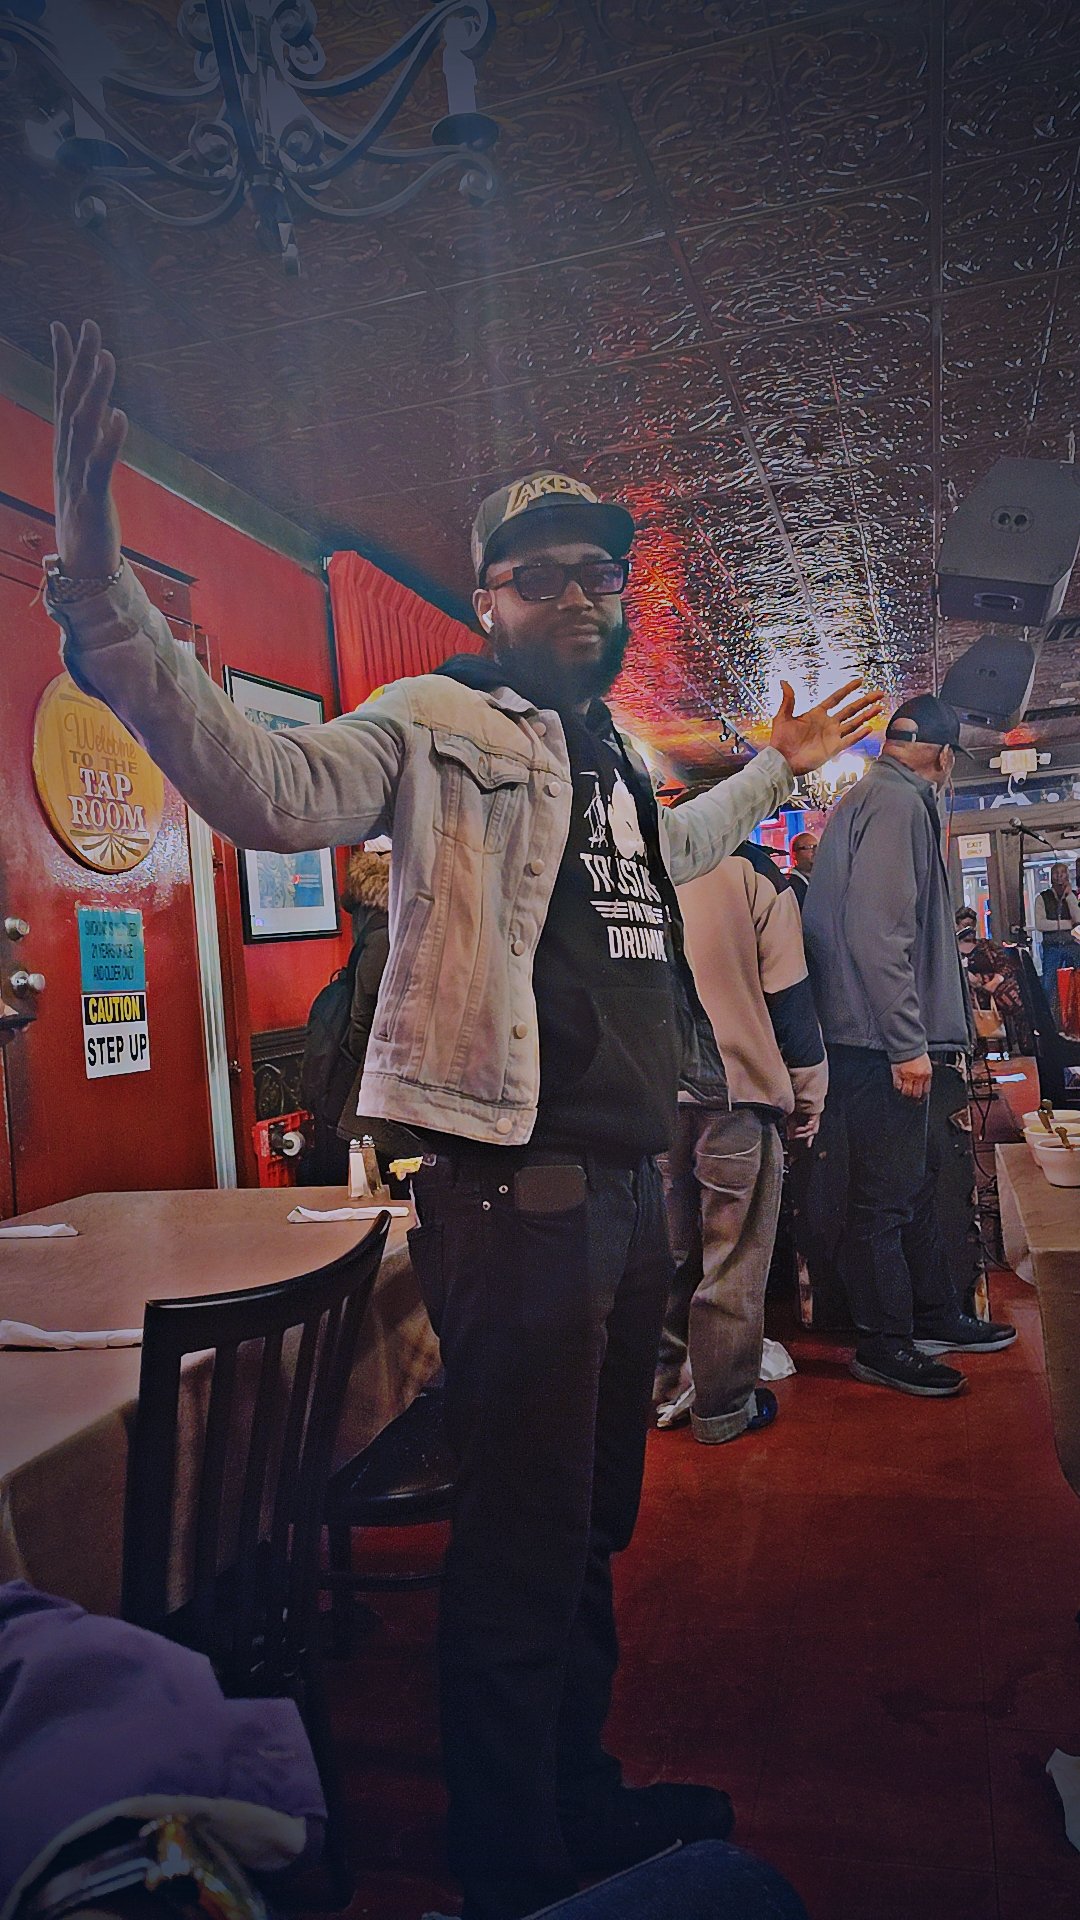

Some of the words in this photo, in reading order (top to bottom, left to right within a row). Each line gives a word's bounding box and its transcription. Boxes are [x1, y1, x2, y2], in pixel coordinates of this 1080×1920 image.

[64, 714, 136, 757] Welcome
[69, 750, 95, 768] TO
[101, 757, 139, 775] THE
[79, 768, 134, 803] TAP
[68, 795, 147, 832] ROOM
[88, 996, 141, 1024] CAUTION
[87, 1035, 124, 1067] STEP
[128, 1033, 147, 1062] UP
